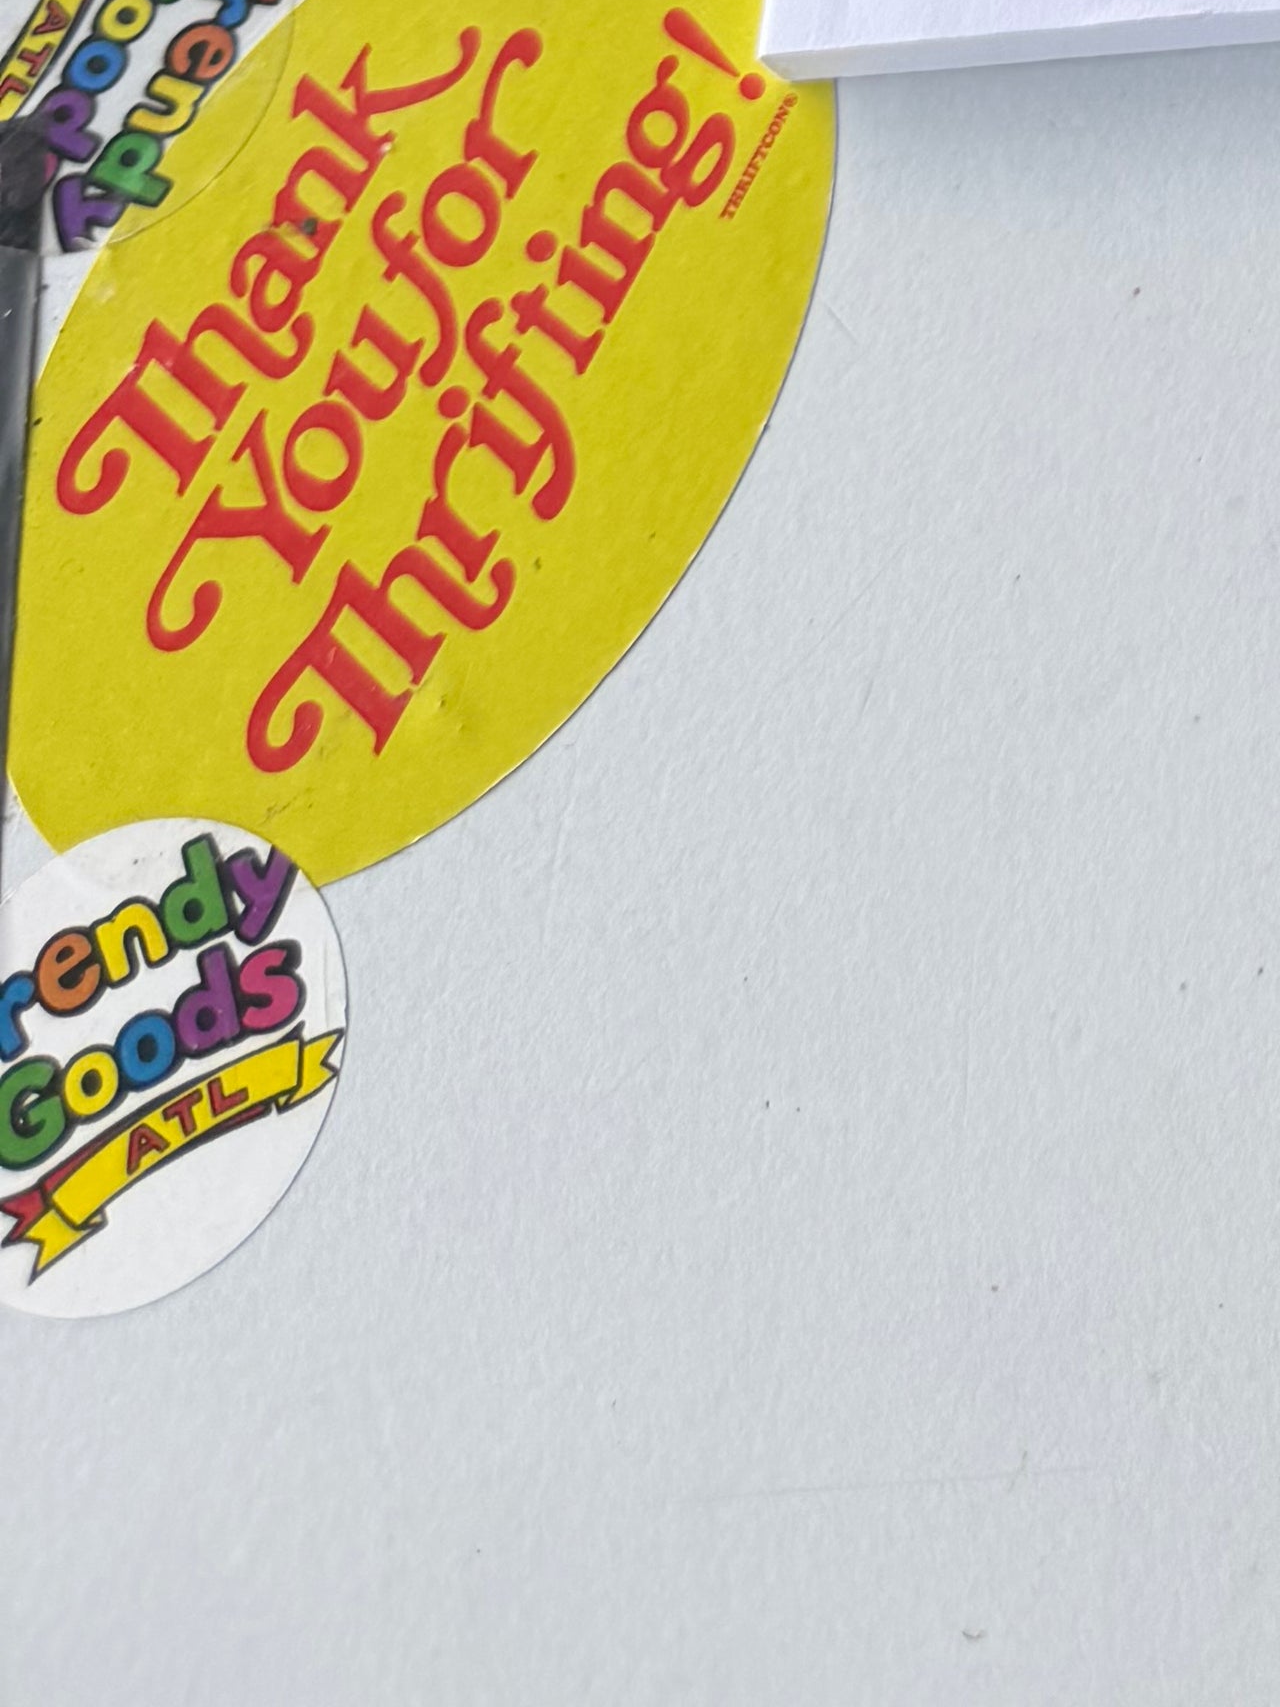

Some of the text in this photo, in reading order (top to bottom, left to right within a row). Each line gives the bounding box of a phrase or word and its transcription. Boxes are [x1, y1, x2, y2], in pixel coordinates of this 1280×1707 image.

[55, 25, 483, 516] Thank
[145, 25, 544, 653] You for
[245, 6, 767, 774] Thrifting!
[0, 832, 303, 1069] rendy
[0, 940, 305, 1171] Goods
[122, 1080, 254, 1177] ATL
